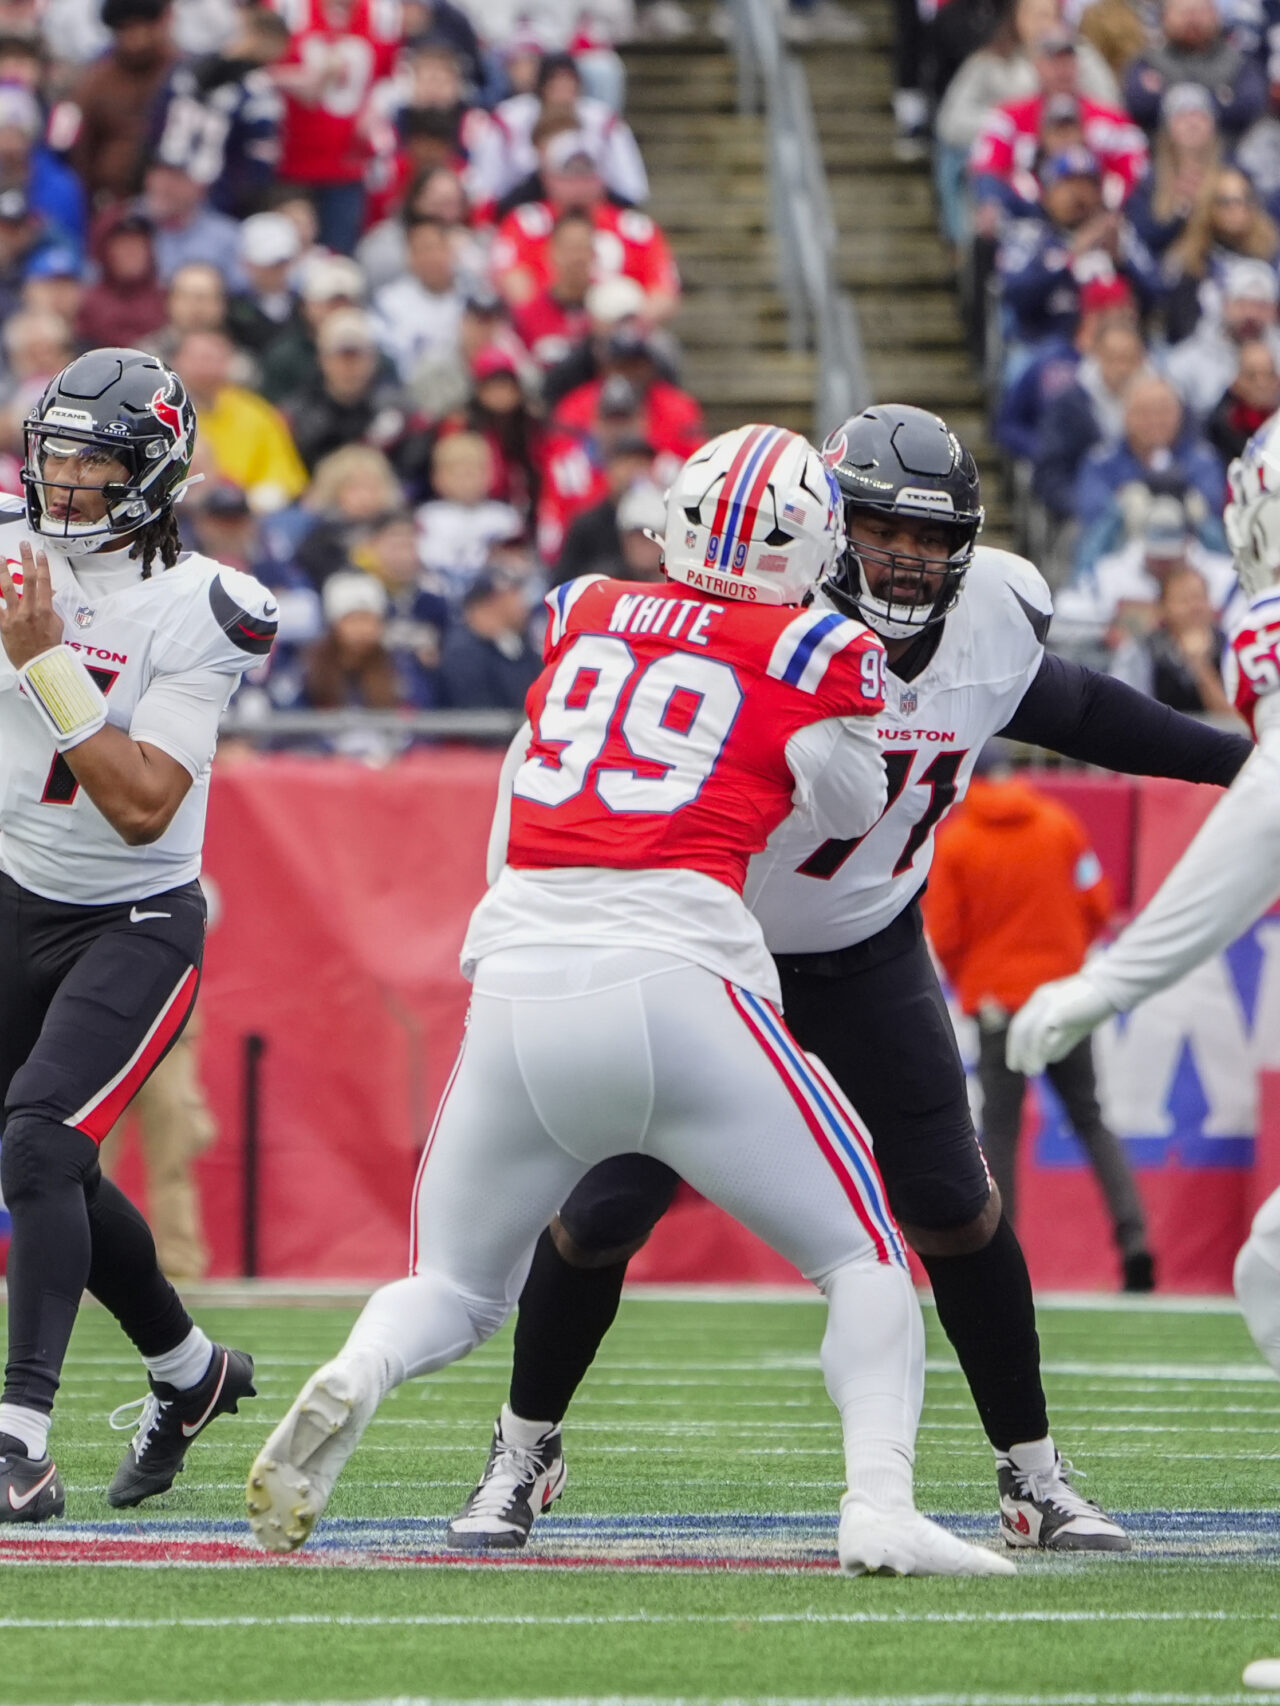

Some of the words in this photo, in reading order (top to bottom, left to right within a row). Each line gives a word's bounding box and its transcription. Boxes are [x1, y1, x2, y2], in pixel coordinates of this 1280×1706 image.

[51, 410, 87, 420] TEXANS
[906, 493, 949, 502] TEXANS
[707, 536, 719, 561] 9
[734, 543, 747, 567] 9
[687, 569, 757, 601] PATRIOTS
[607, 593, 725, 646] WHITE
[64, 640, 128, 665] STON
[1237, 628, 1280, 696] 5
[511, 633, 746, 814] 99
[877, 728, 956, 743] USTON
[795, 748, 971, 881] 71
